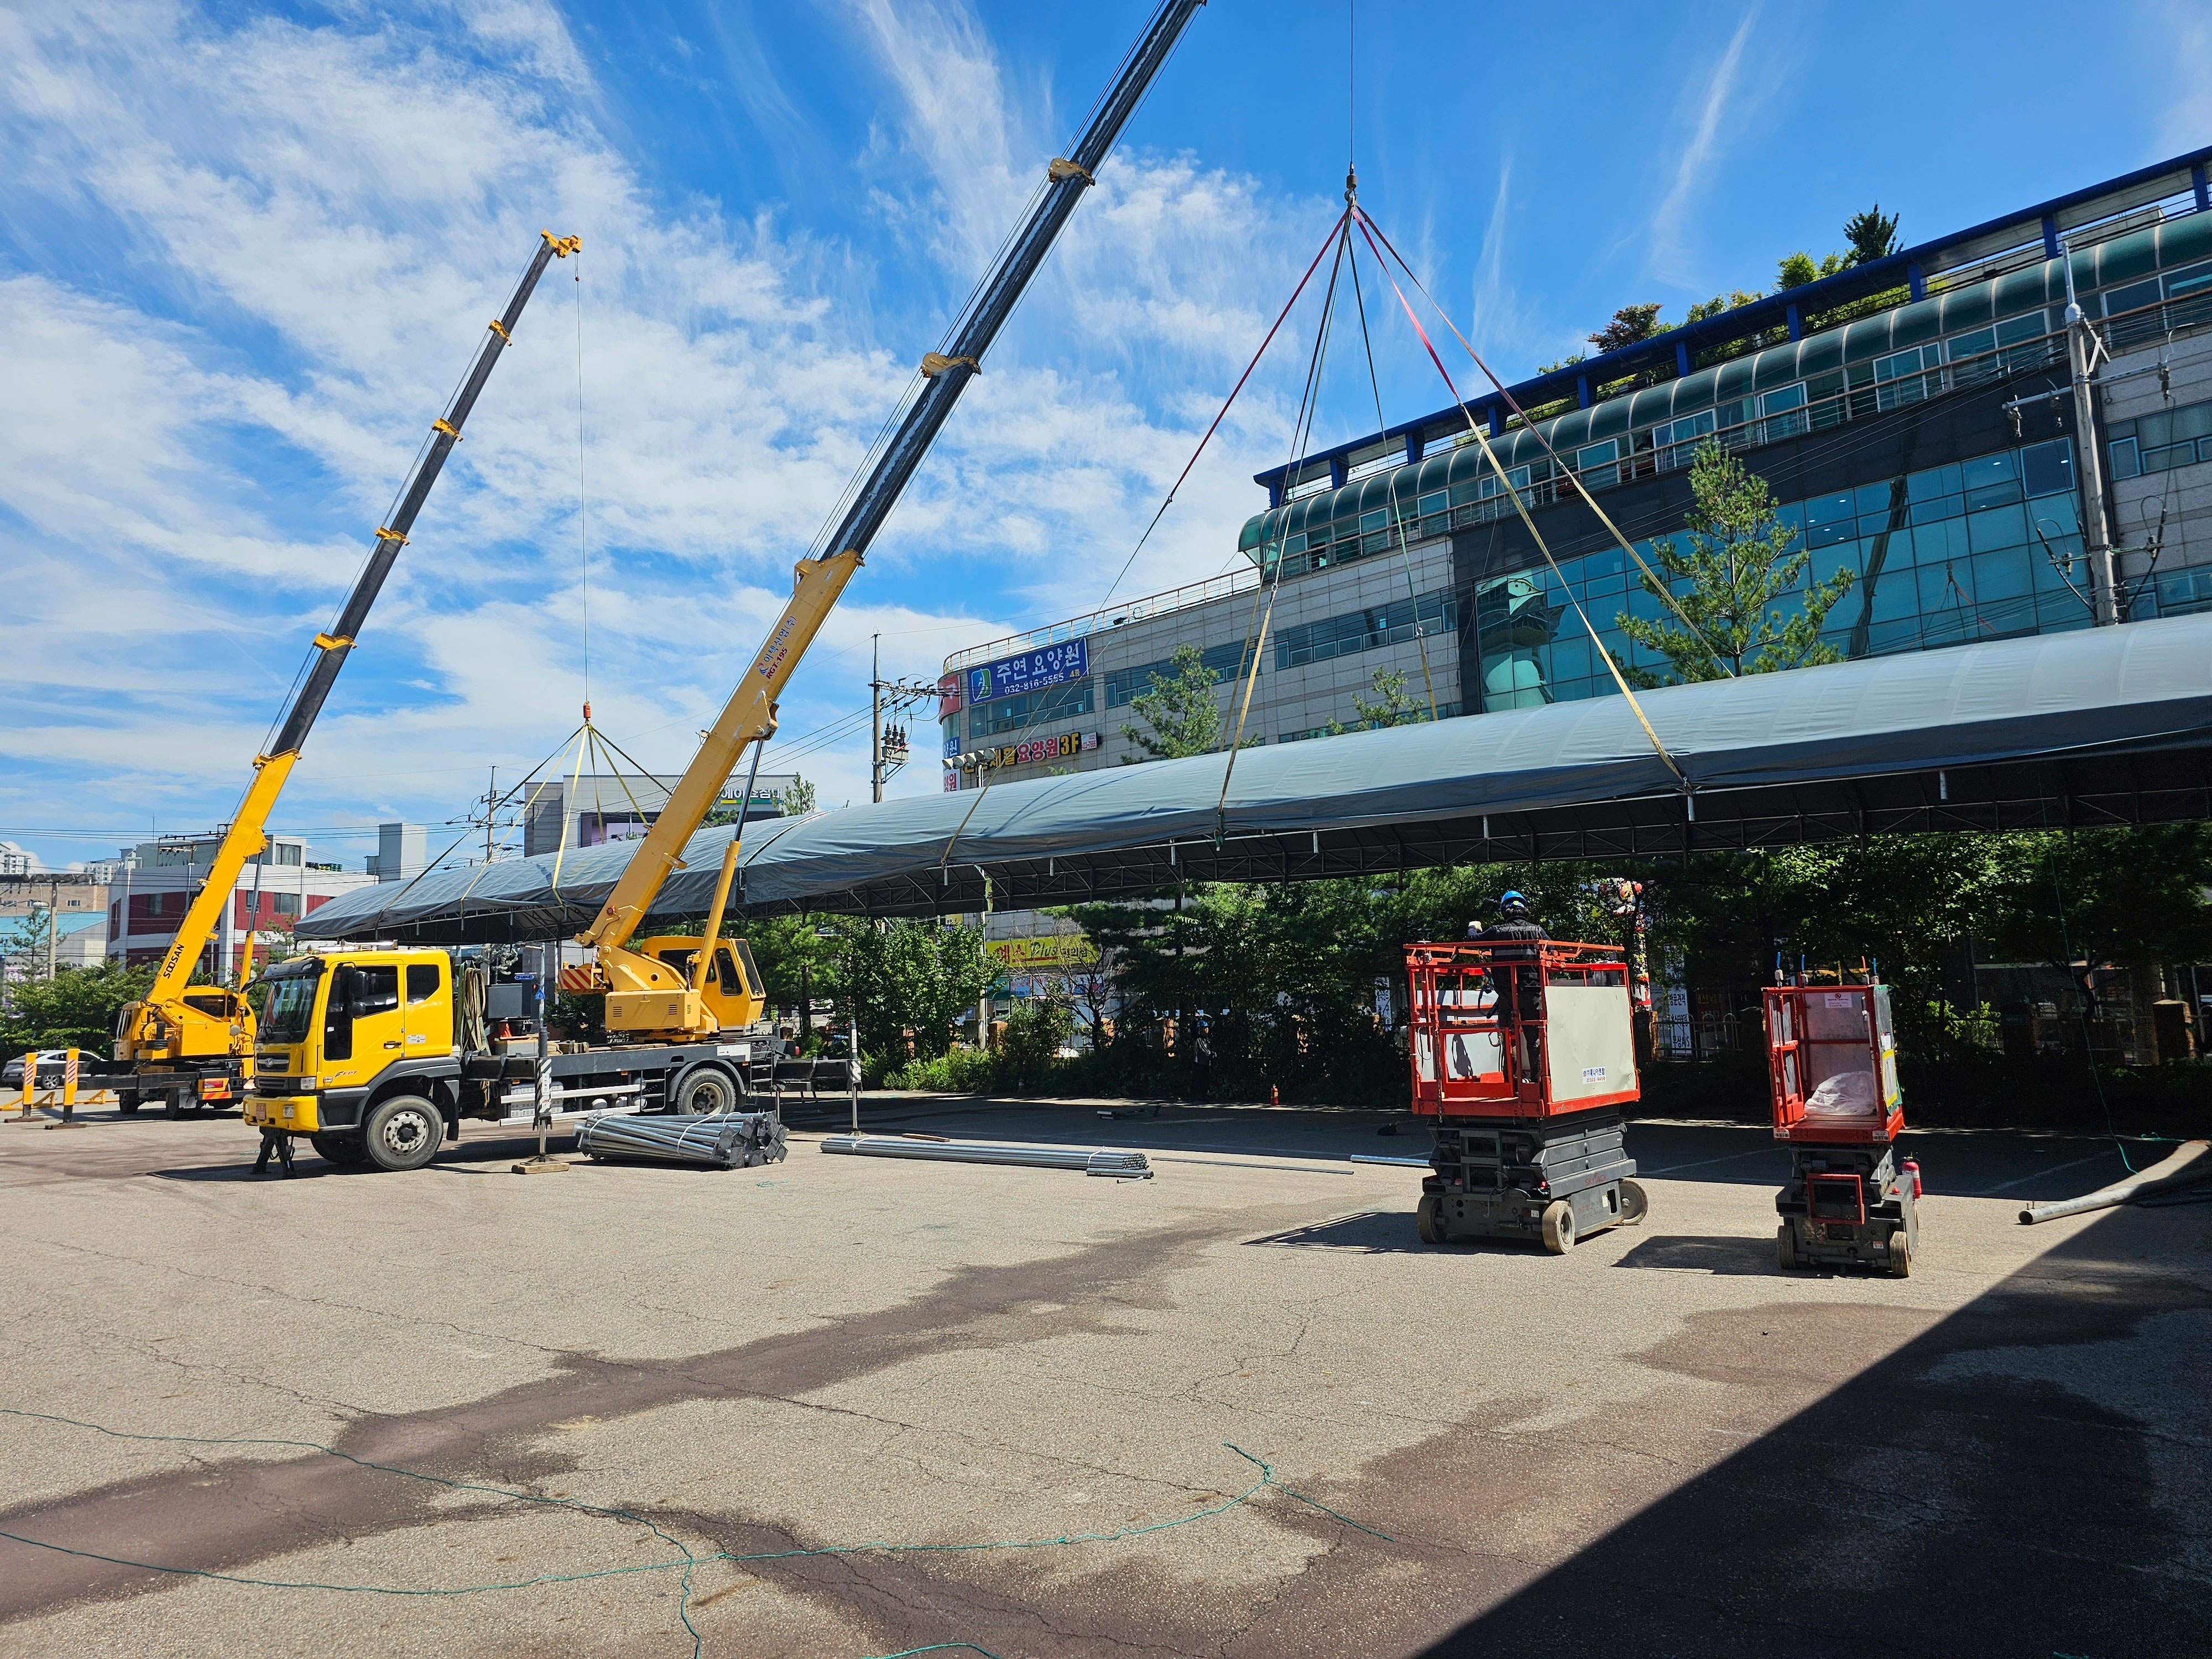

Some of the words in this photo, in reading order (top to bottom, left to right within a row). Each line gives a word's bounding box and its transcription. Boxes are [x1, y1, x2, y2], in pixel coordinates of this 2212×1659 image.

[766, 647, 787, 680] RGT-195
[997, 658, 1027, 684] 주연
[1032, 643, 1080, 676] 요양원
[163, 943, 185, 979] SOOSAN
[1670, 993, 1686, 1006] 방문견적
